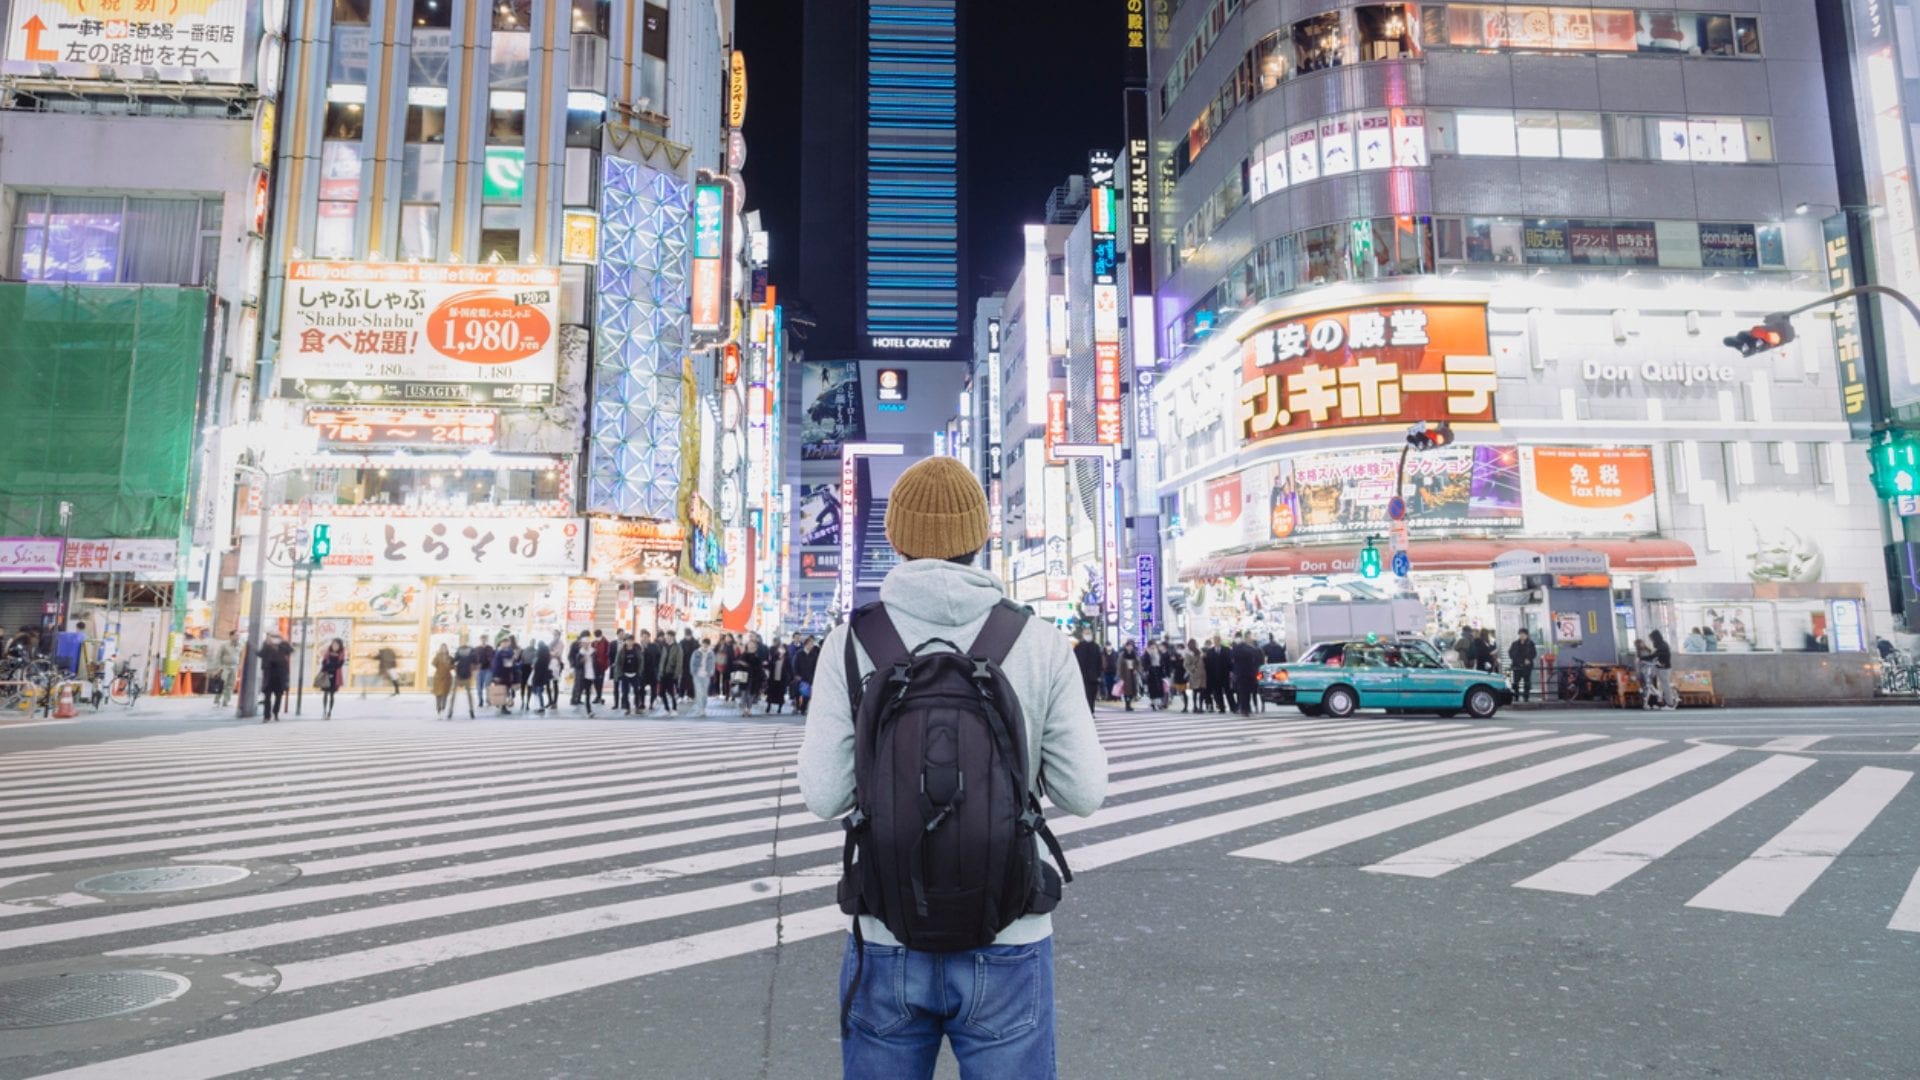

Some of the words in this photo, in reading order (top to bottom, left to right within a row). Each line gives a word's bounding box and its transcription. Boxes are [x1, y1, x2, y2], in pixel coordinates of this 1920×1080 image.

[65, 41, 220, 67] 左の路地を右へ
[1358, 116, 1422, 129] OPN
[1526, 228, 1564, 248] 販売
[1616, 234, 1652, 248] 時計
[299, 287, 426, 309] しゃぶしゃぶ
[443, 319, 519, 354] 1,980
[873, 337, 905, 349] HOTEL
[906, 337, 952, 349] GRACERY
[1583, 359, 1634, 382] Don
[1640, 360, 1734, 386] Quijote
[1571, 485, 1593, 497] Tax
[1595, 485, 1621, 497] Free
[384, 522, 550, 563] とらそば
[64, 542, 109, 568] 営業中
[1300, 559, 1327, 572] Don
[464, 602, 529, 619] とらそば
